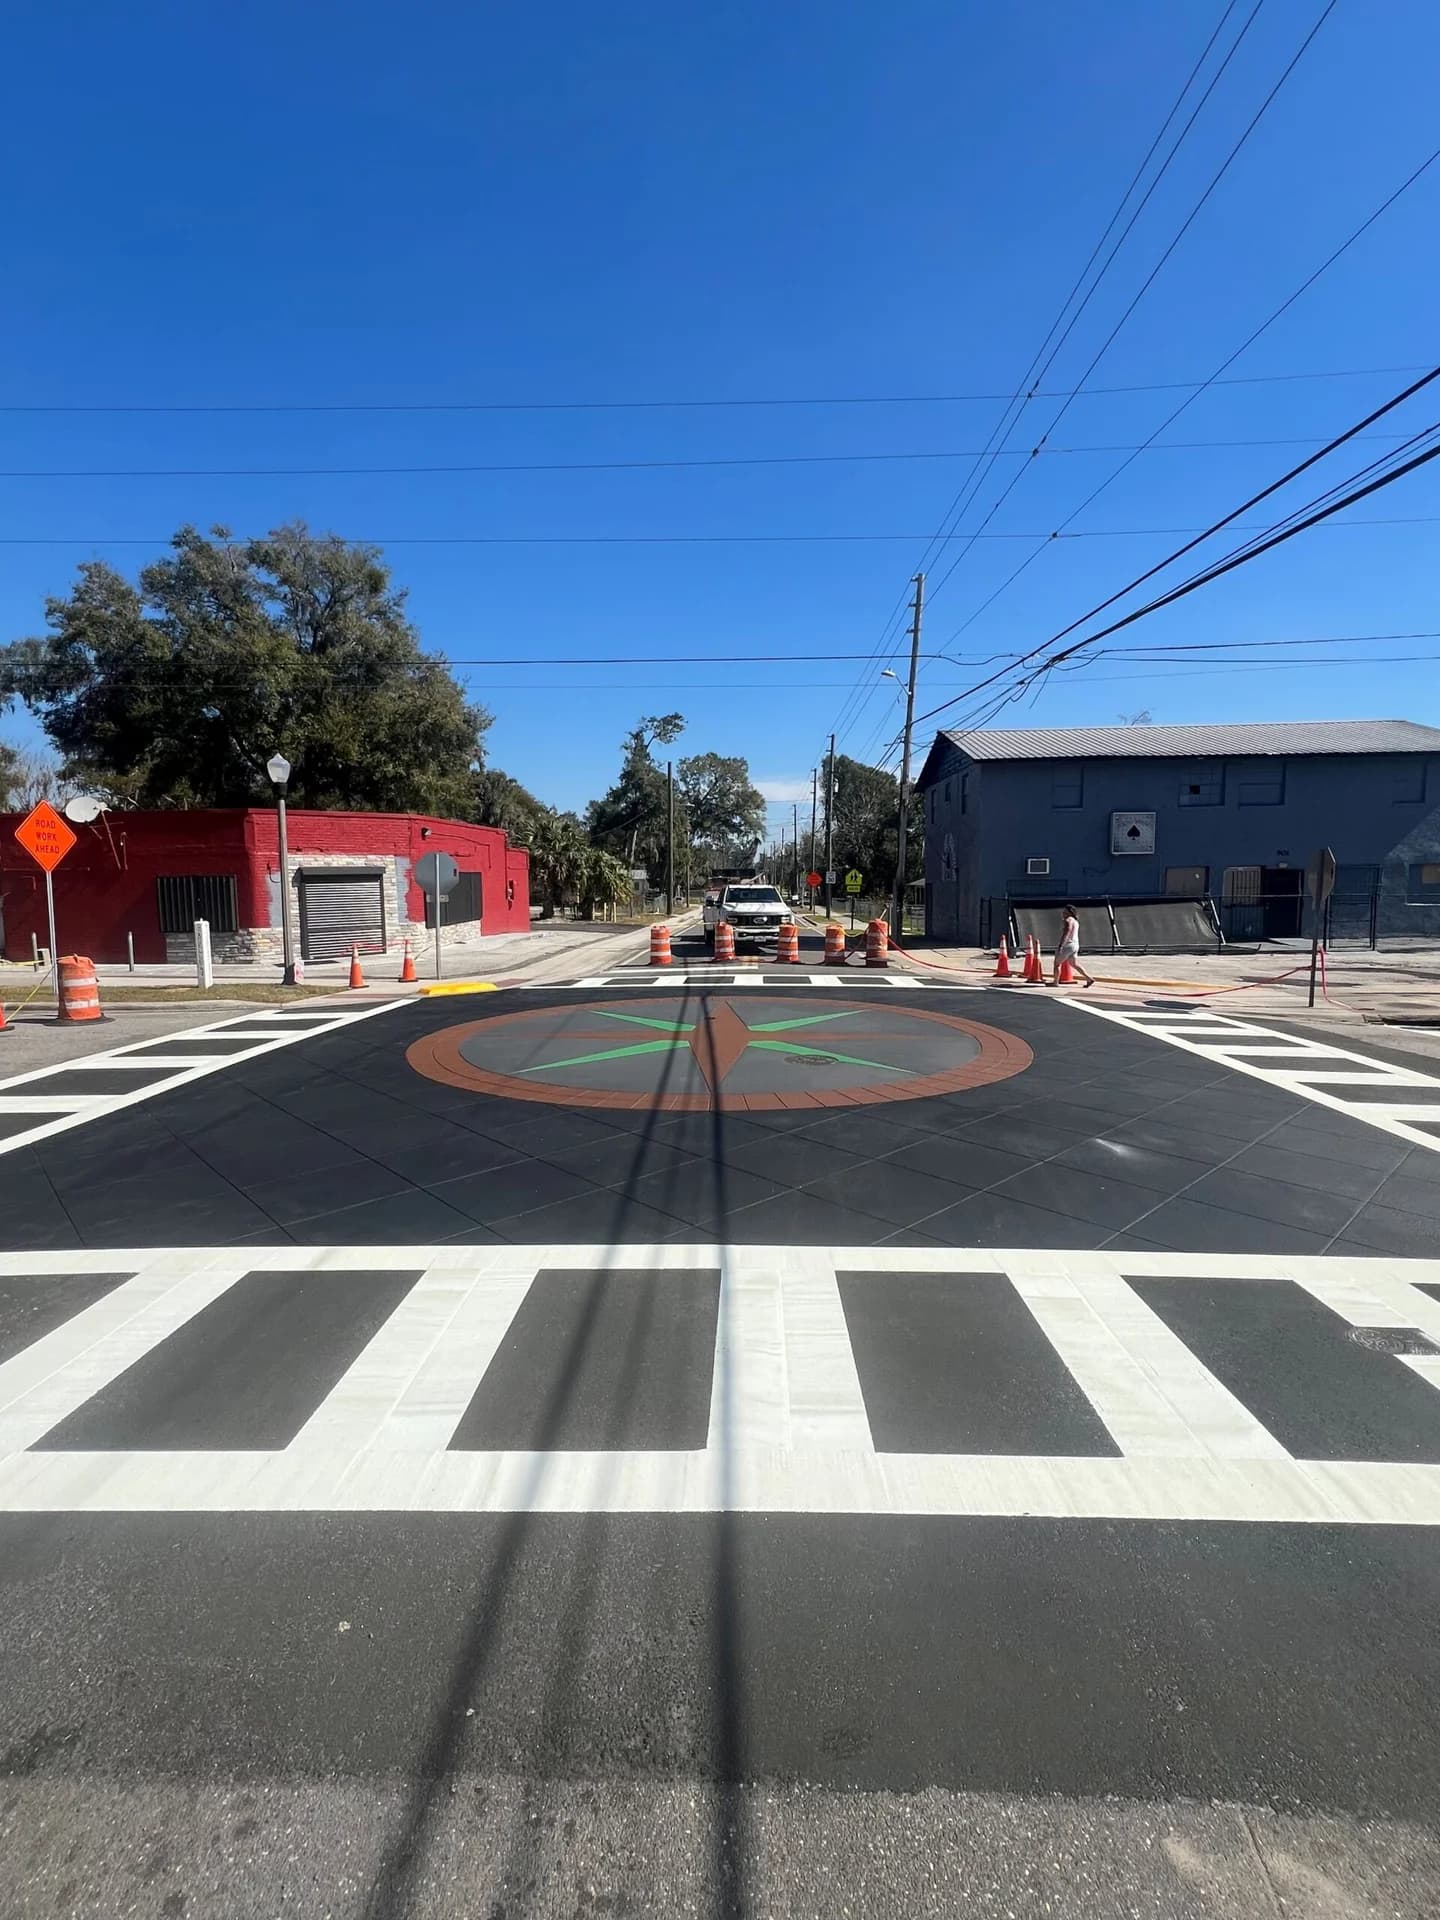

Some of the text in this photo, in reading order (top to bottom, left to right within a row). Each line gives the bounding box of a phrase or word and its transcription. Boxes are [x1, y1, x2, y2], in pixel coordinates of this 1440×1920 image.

[35, 819, 56, 829] ROAD
[35, 831, 57, 841] WORK
[35, 844, 60, 854] AHEAD
